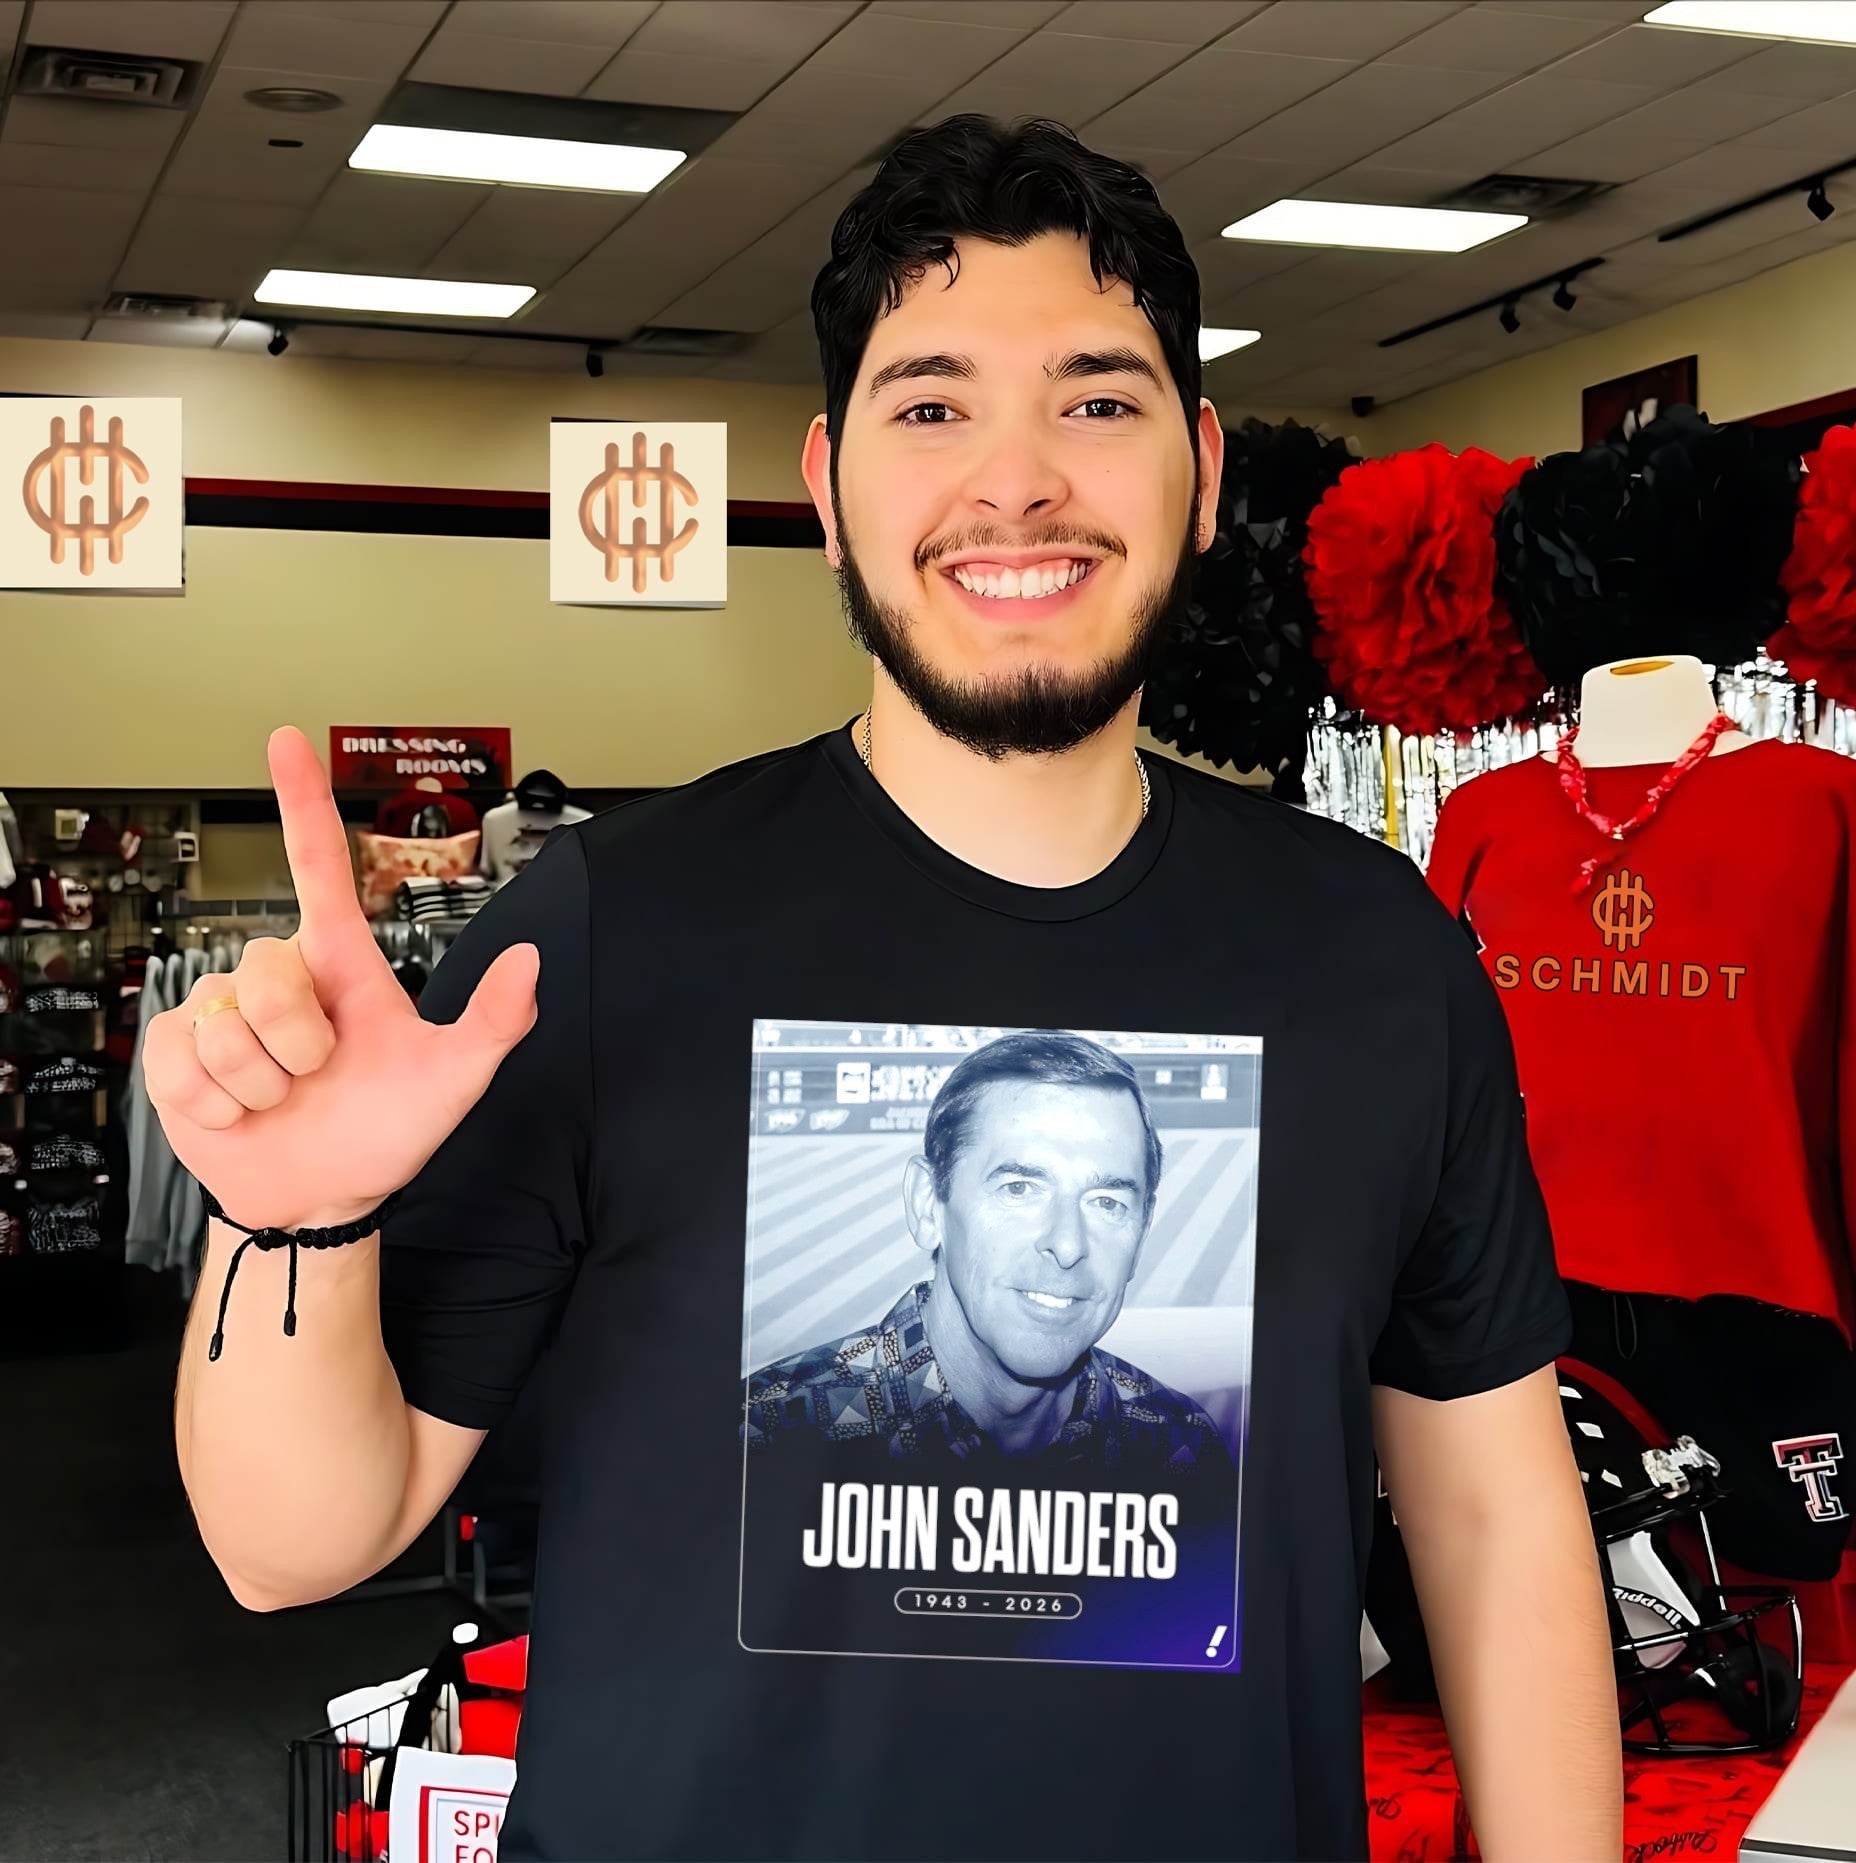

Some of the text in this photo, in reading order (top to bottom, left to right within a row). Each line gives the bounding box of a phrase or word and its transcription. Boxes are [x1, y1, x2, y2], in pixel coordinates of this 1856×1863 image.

[1494, 954, 1747, 1000] SCHMIDT
[802, 1482, 1180, 1581] JOHN SANDERS
[913, 1593, 968, 1610] 1943
[1004, 1596, 1064, 1613] 2026
